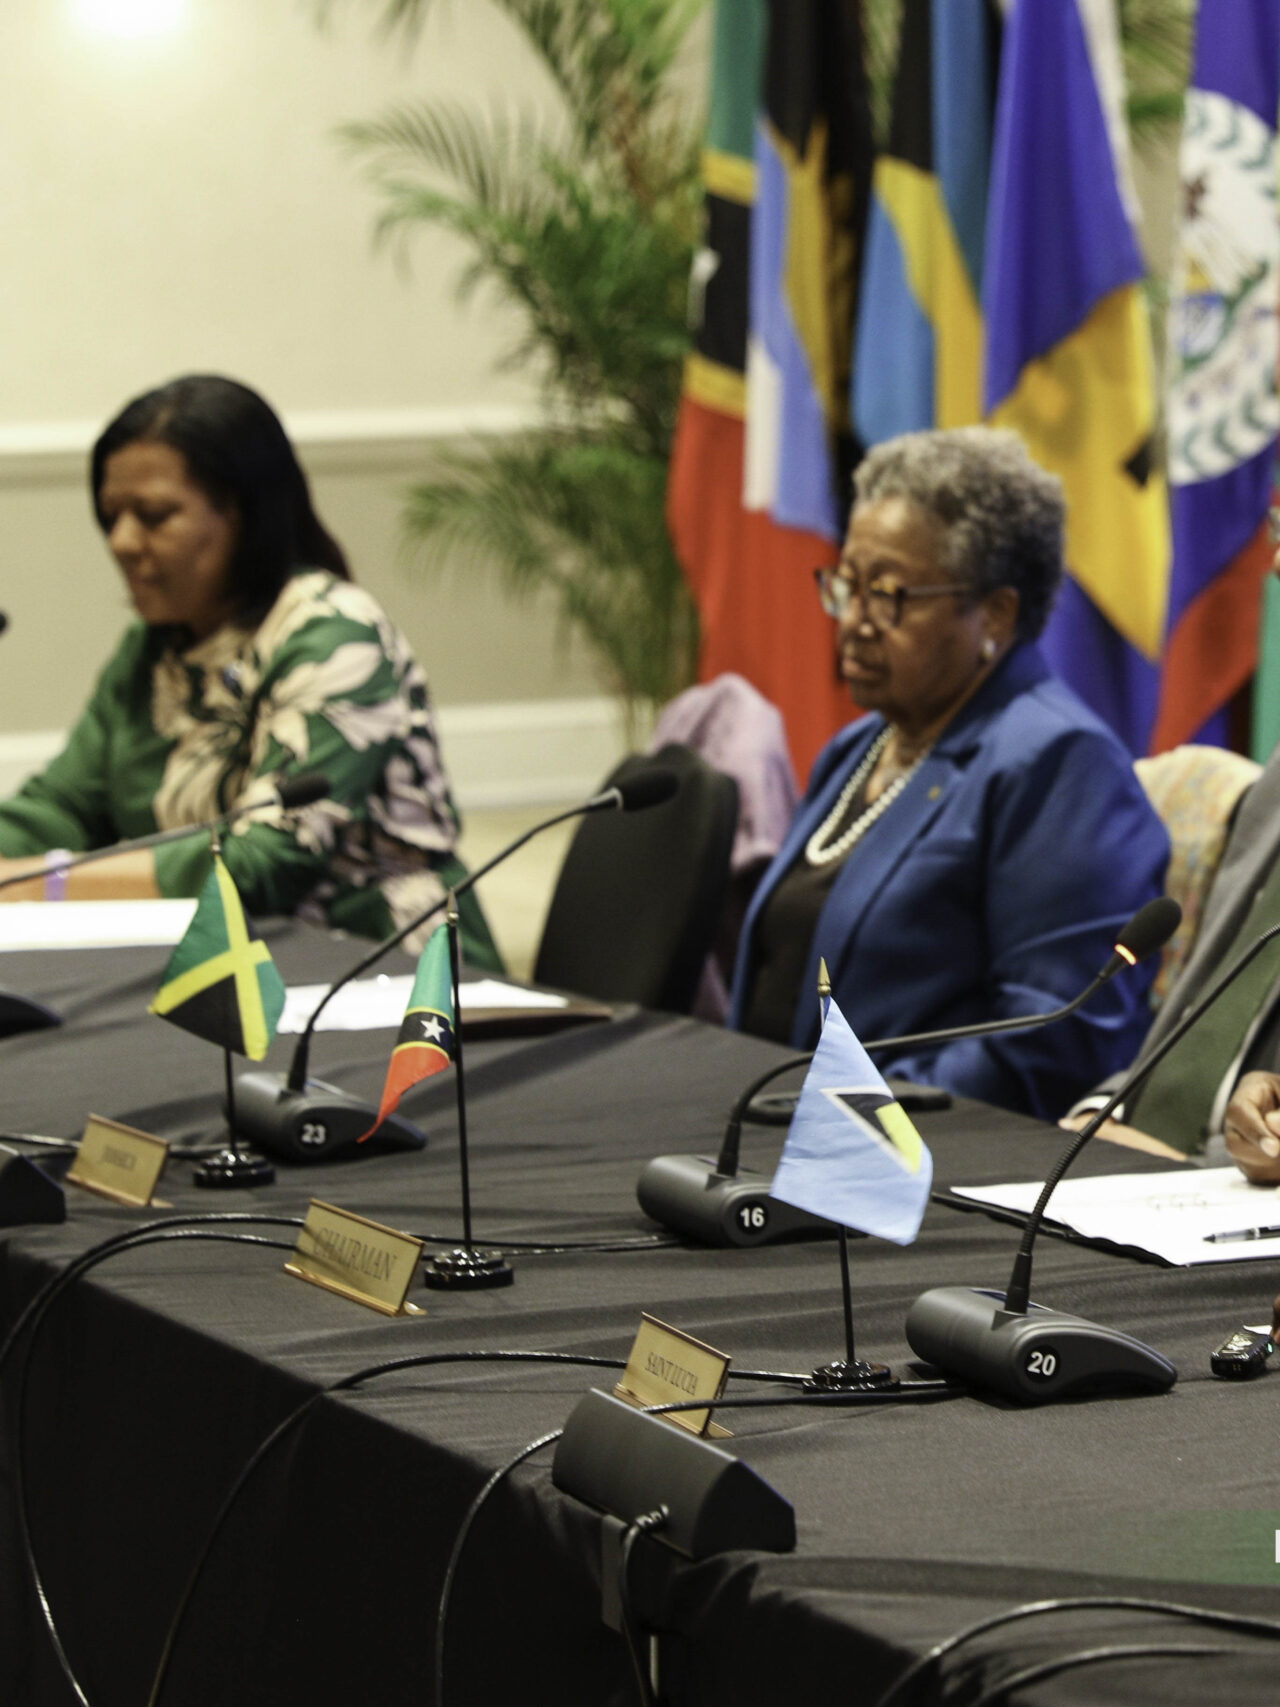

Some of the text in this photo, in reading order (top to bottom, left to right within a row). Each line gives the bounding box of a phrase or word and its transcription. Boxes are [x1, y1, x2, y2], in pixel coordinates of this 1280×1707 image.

[302, 1123, 326, 1144] 23
[740, 1207, 765, 1227] 16
[1027, 1351, 1056, 1376] 20
